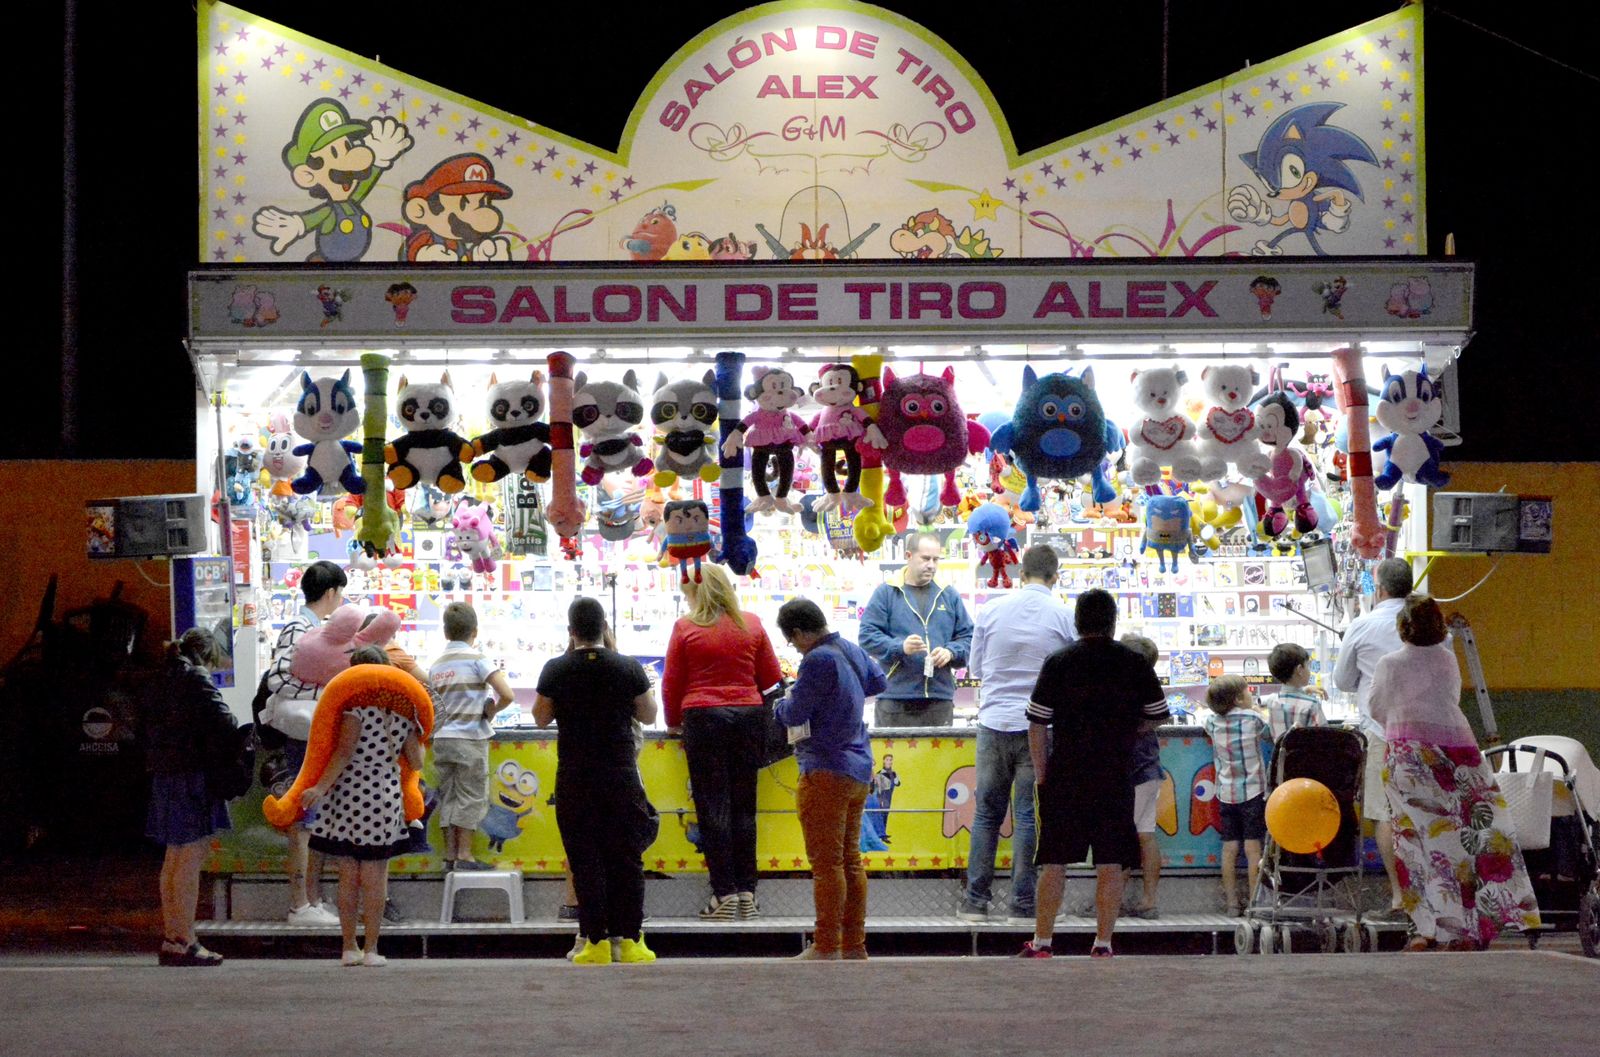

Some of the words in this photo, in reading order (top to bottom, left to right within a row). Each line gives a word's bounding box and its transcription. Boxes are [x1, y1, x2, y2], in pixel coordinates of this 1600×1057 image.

[659, 26, 798, 132] SALÓN
[815, 25, 880, 59] DE
[897, 46, 977, 136] TIRO
[756, 74, 880, 100] ALEX
[782, 115, 846, 142] G&M
[450, 284, 698, 325] SALON
[724, 284, 818, 322] DE
[844, 283, 1007, 321] TIRO
[1033, 282, 1219, 320] ALEX
[195, 565, 220, 581] OCB
